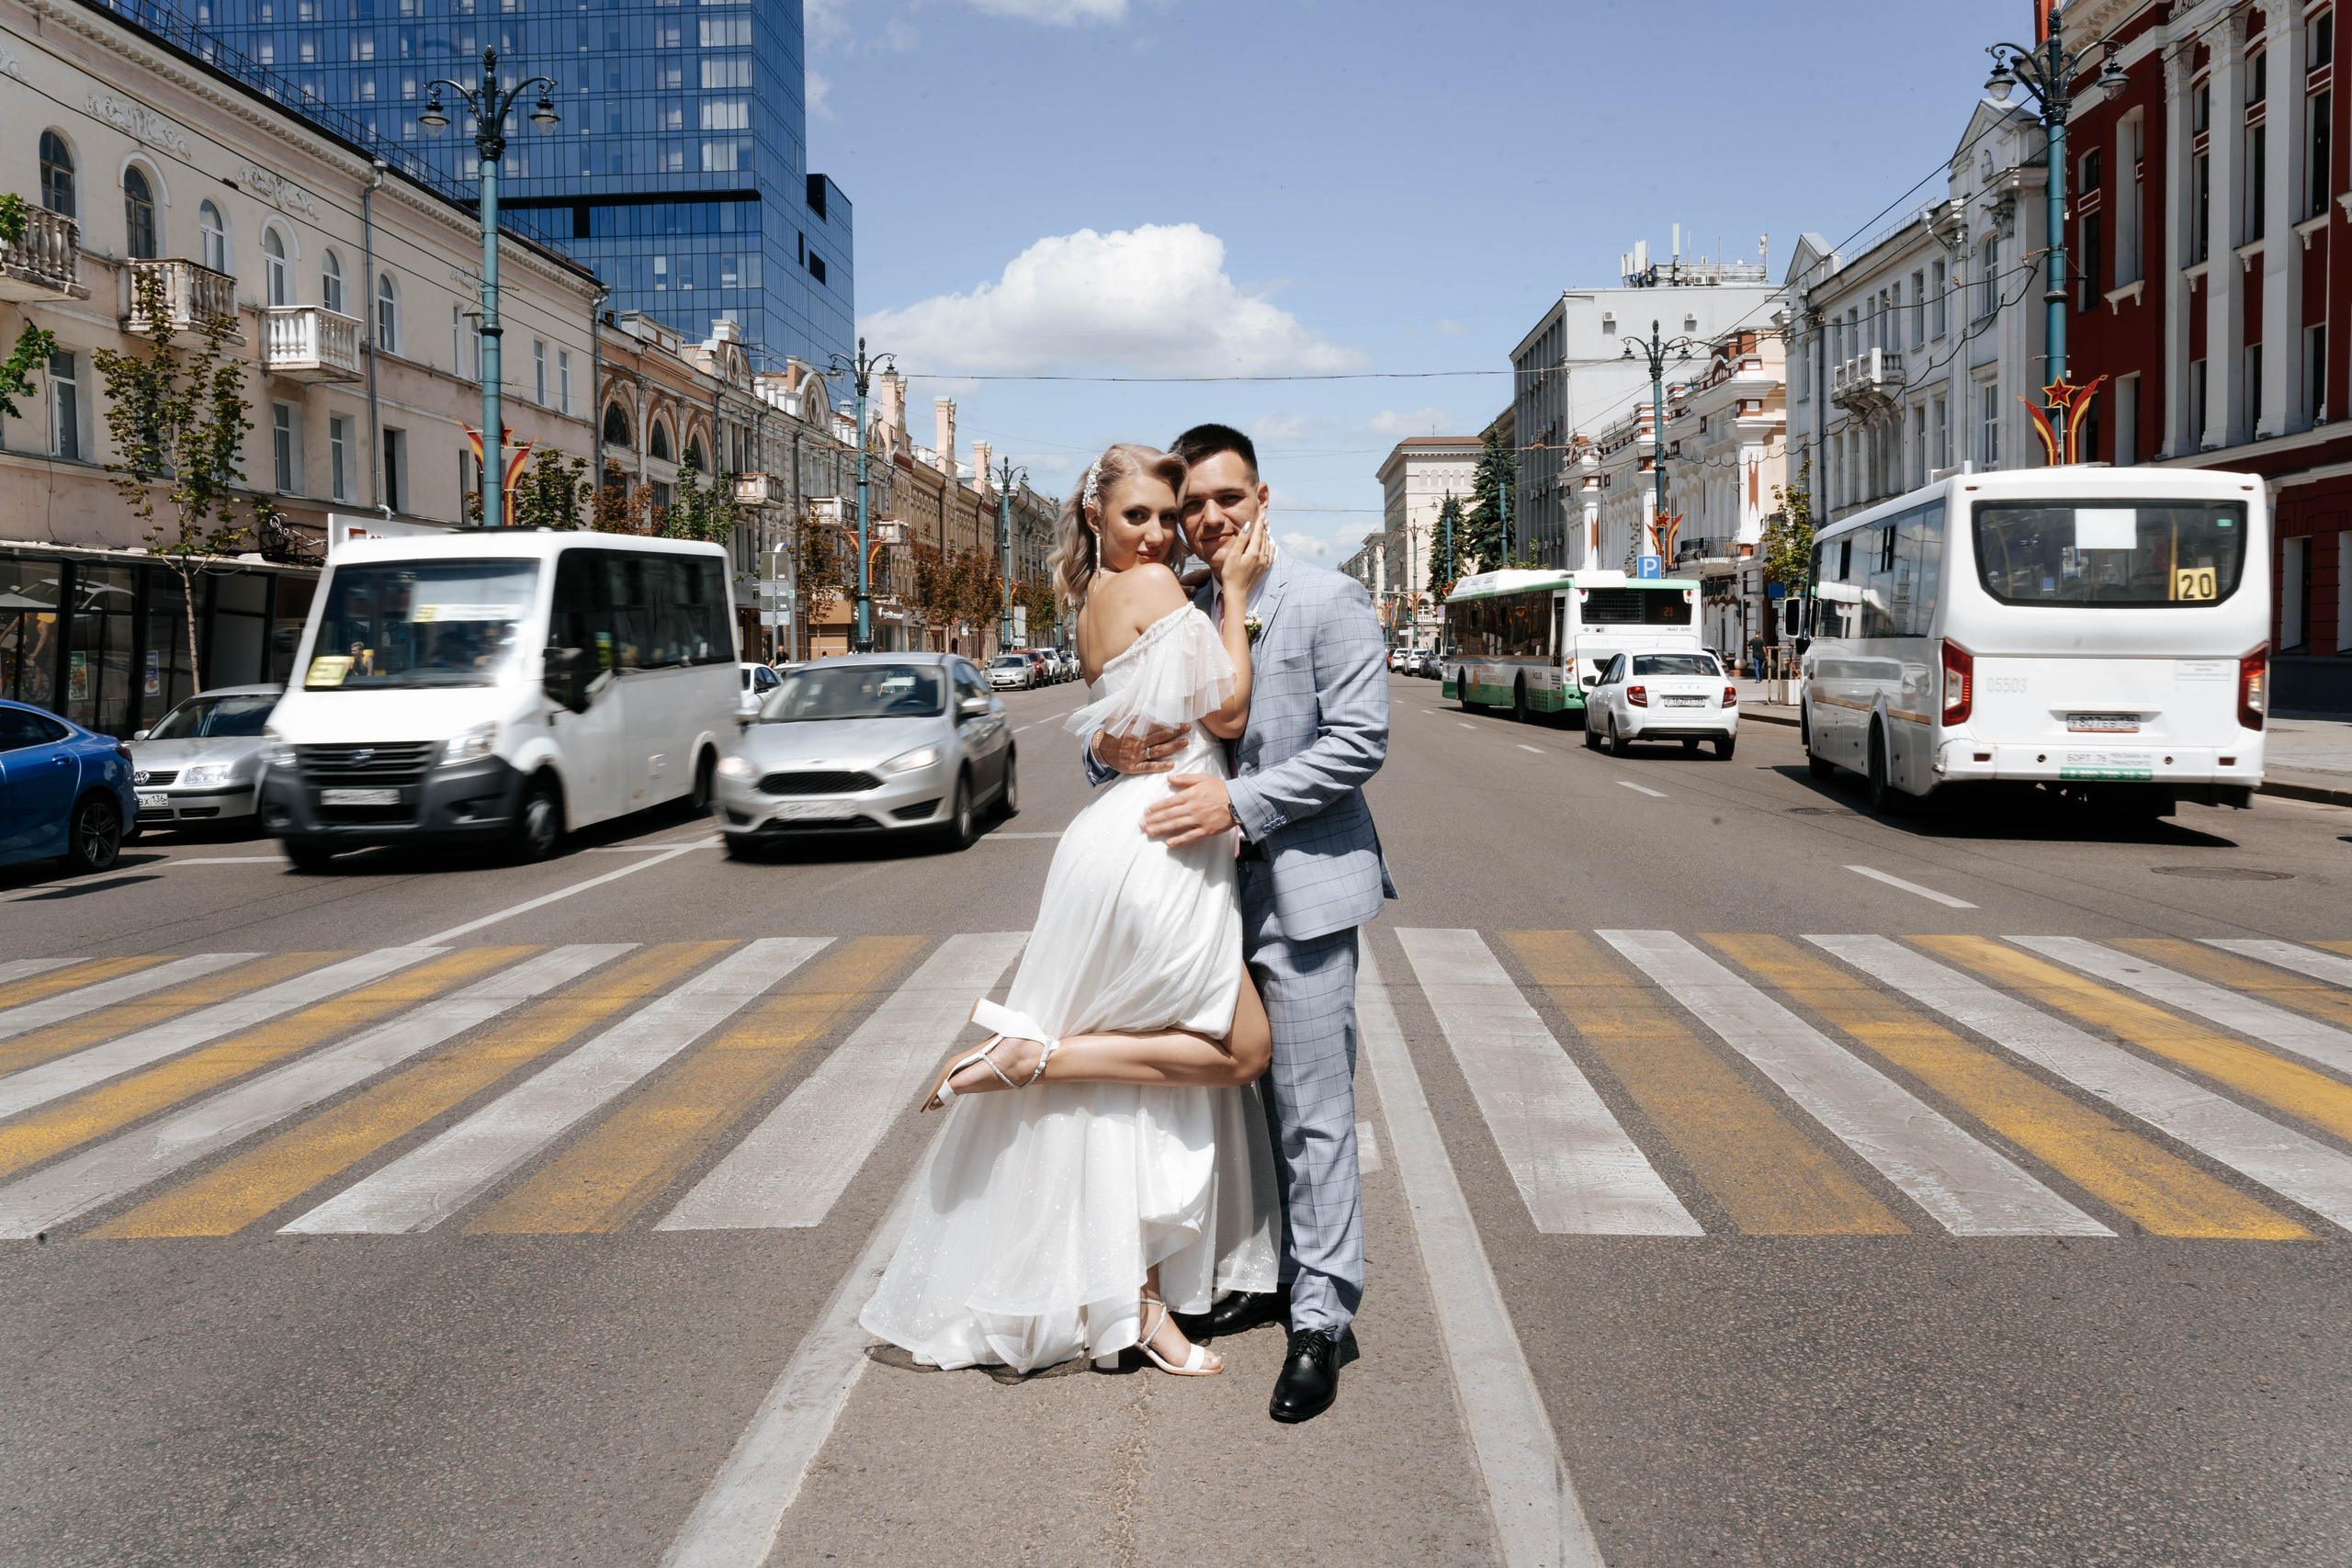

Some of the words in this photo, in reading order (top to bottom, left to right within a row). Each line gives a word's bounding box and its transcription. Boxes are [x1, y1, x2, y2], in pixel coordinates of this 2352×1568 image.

[1643, 558, 1657, 577] P
[2181, 573, 2211, 599] 20
[1664, 606, 1673, 616] 21
[1986, 678, 2027, 693] 05503
[151, 795, 165, 803] 136
